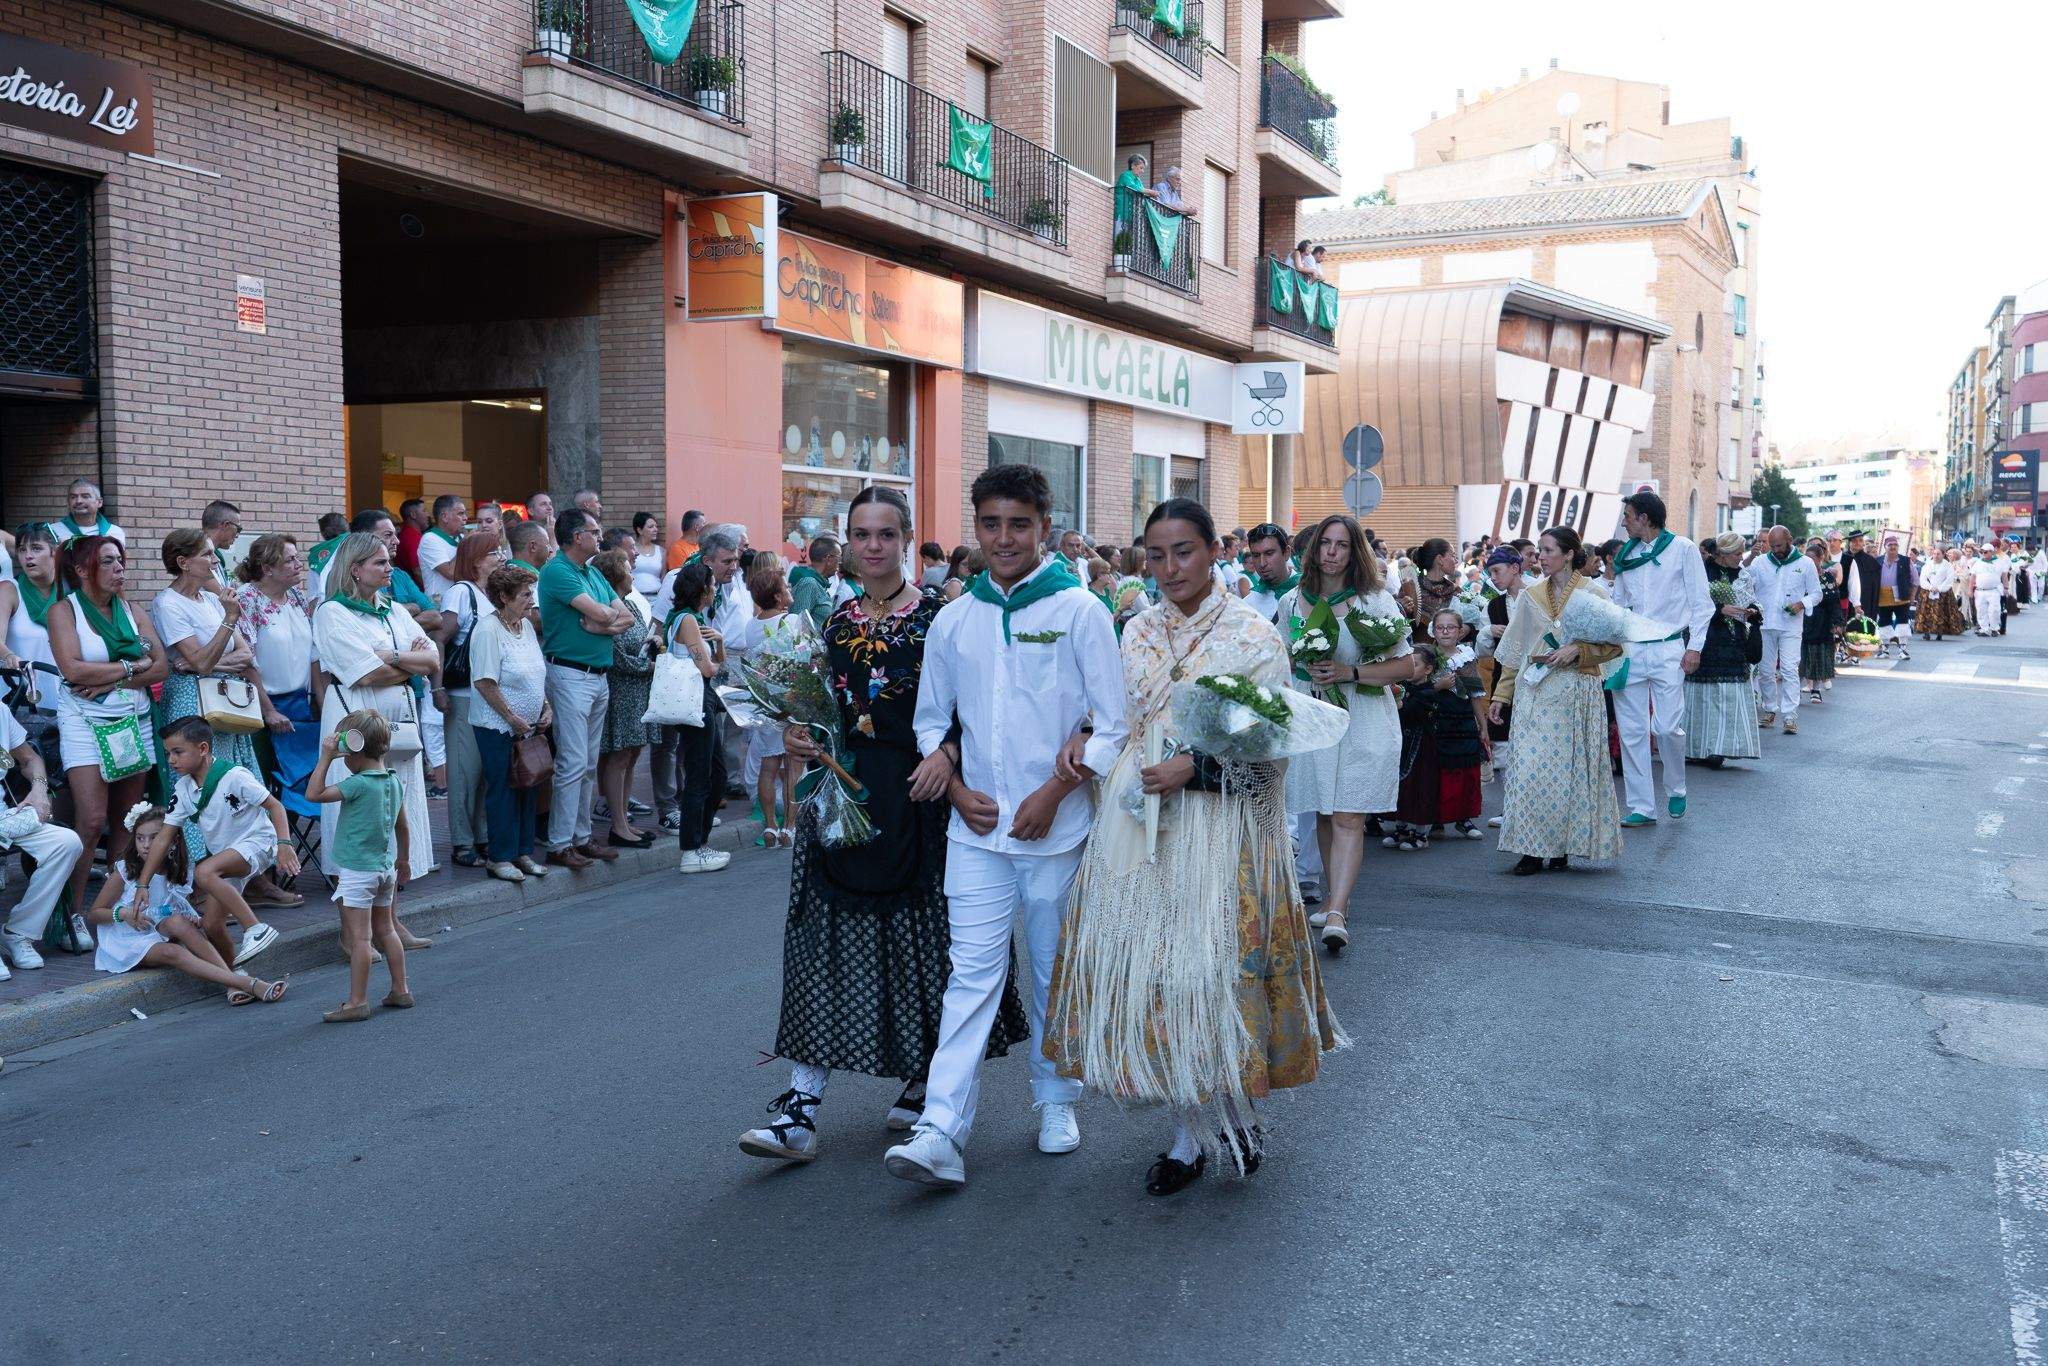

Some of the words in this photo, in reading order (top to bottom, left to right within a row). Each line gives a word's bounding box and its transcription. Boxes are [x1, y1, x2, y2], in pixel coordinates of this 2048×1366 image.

[89, 86, 139, 135] Lei
[687, 234, 764, 262] Capricho
[777, 256, 863, 316] Capricho
[1049, 319, 1190, 408] MICAELA
